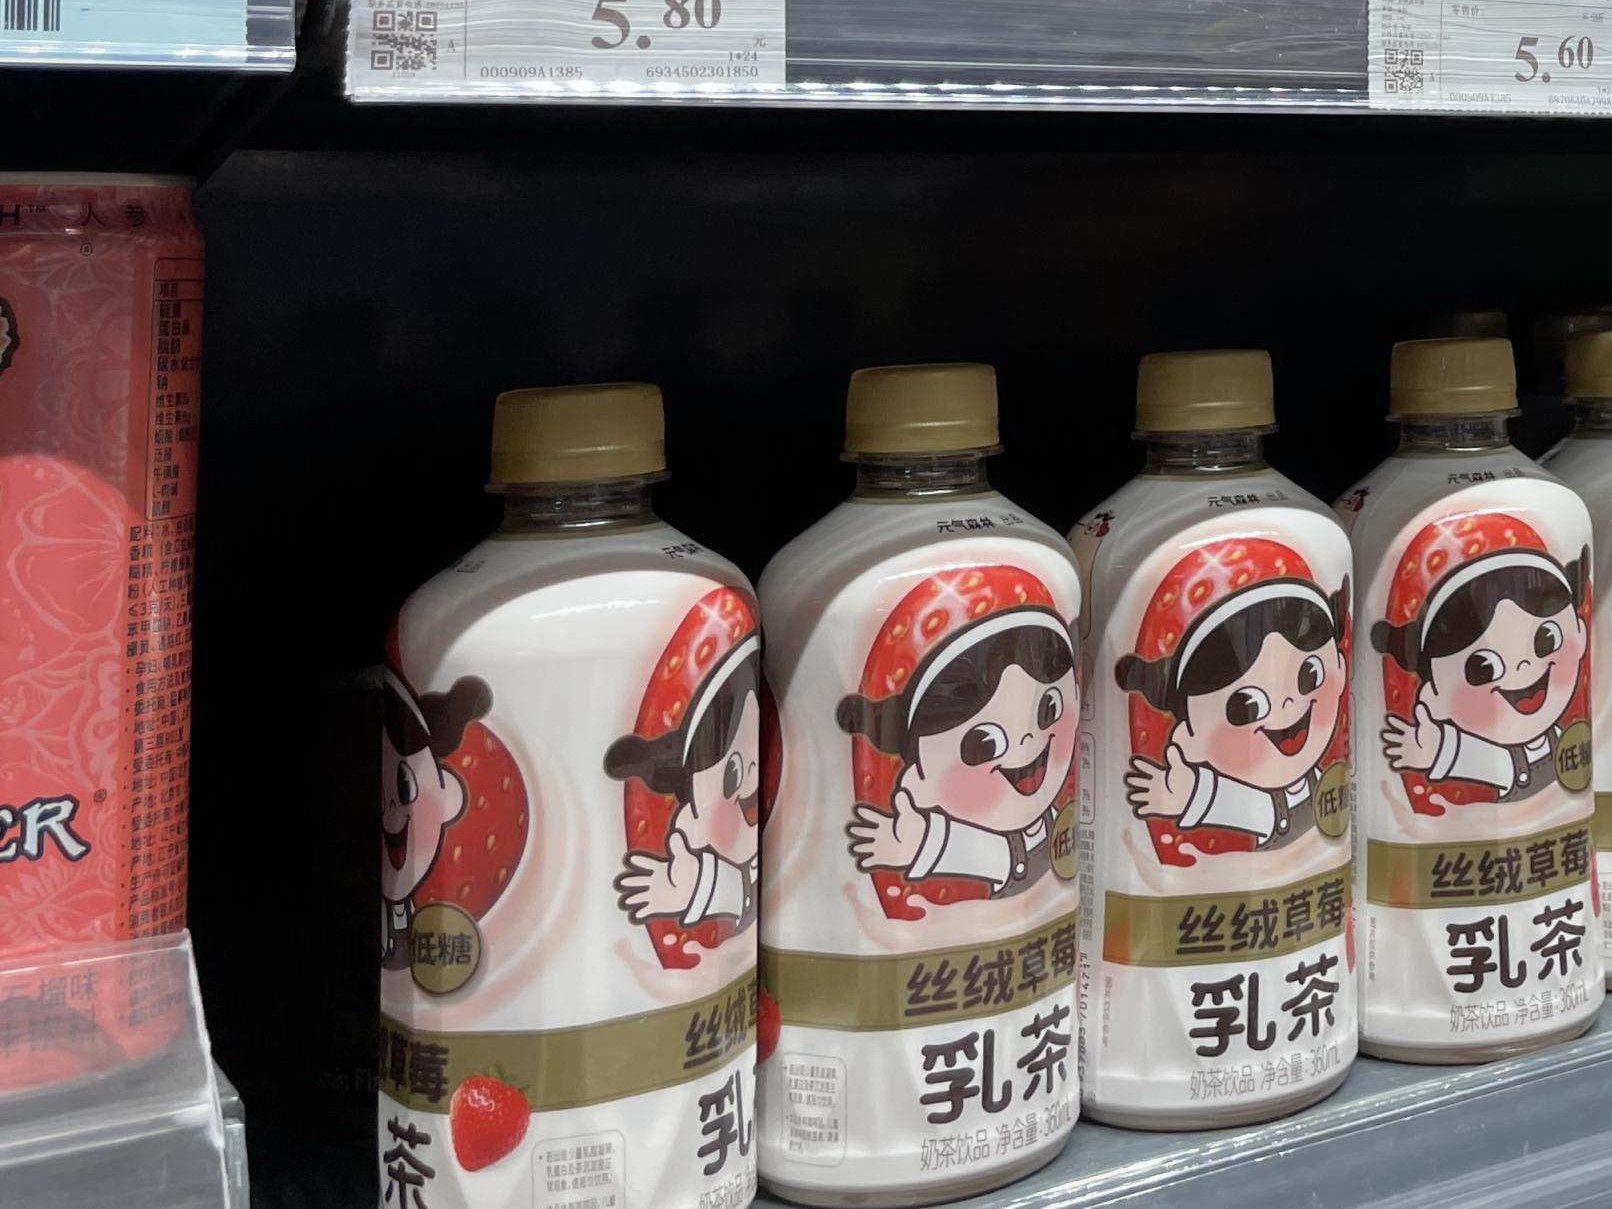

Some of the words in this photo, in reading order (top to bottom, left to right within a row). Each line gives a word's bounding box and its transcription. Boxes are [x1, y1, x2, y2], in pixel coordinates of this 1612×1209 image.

[1514, 35, 1594, 83] 5.60
[1206, 491, 1261, 508] 元气森林
[1447, 471, 1496, 485] 元气森林
[0, 793, 92, 863] R
[1431, 828, 1590, 898] 丝绒草莓
[412, 930, 473, 968] 低糖
[1176, 877, 1346, 955] 丝绒草莓
[1447, 898, 1587, 994] 乳茶
[904, 921, 1076, 1017] 丝绒草莓
[1189, 953, 1340, 1058] 乳茶
[1450, 999, 1510, 1034] 奶茶饮品
[380, 1026, 449, 1104] 草莓
[919, 1004, 1071, 1125] 乳茶
[1189, 1064, 1255, 1101] 奶茶饮品
[696, 1070, 754, 1176] 乳
[920, 1128, 991, 1171] 奶茶饮品
